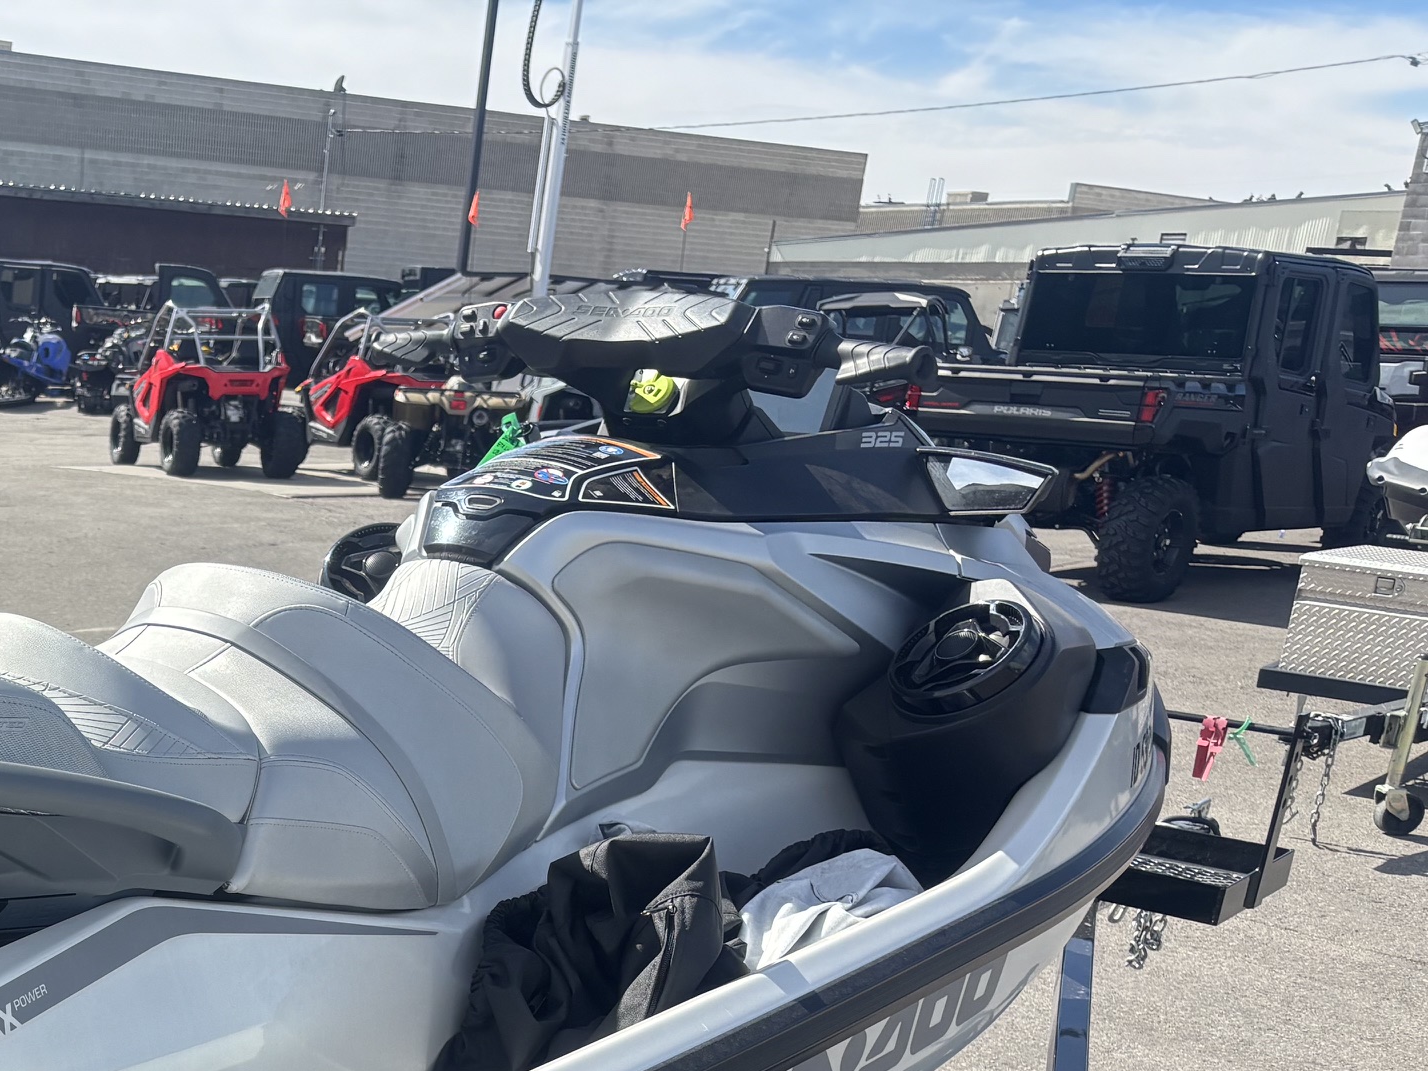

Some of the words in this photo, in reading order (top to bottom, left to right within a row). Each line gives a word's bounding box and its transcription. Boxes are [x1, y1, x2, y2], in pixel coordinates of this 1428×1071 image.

[994, 405, 1052, 416] POLARIS
[860, 432, 905, 448] 325
[13, 983, 49, 1011] POWER
